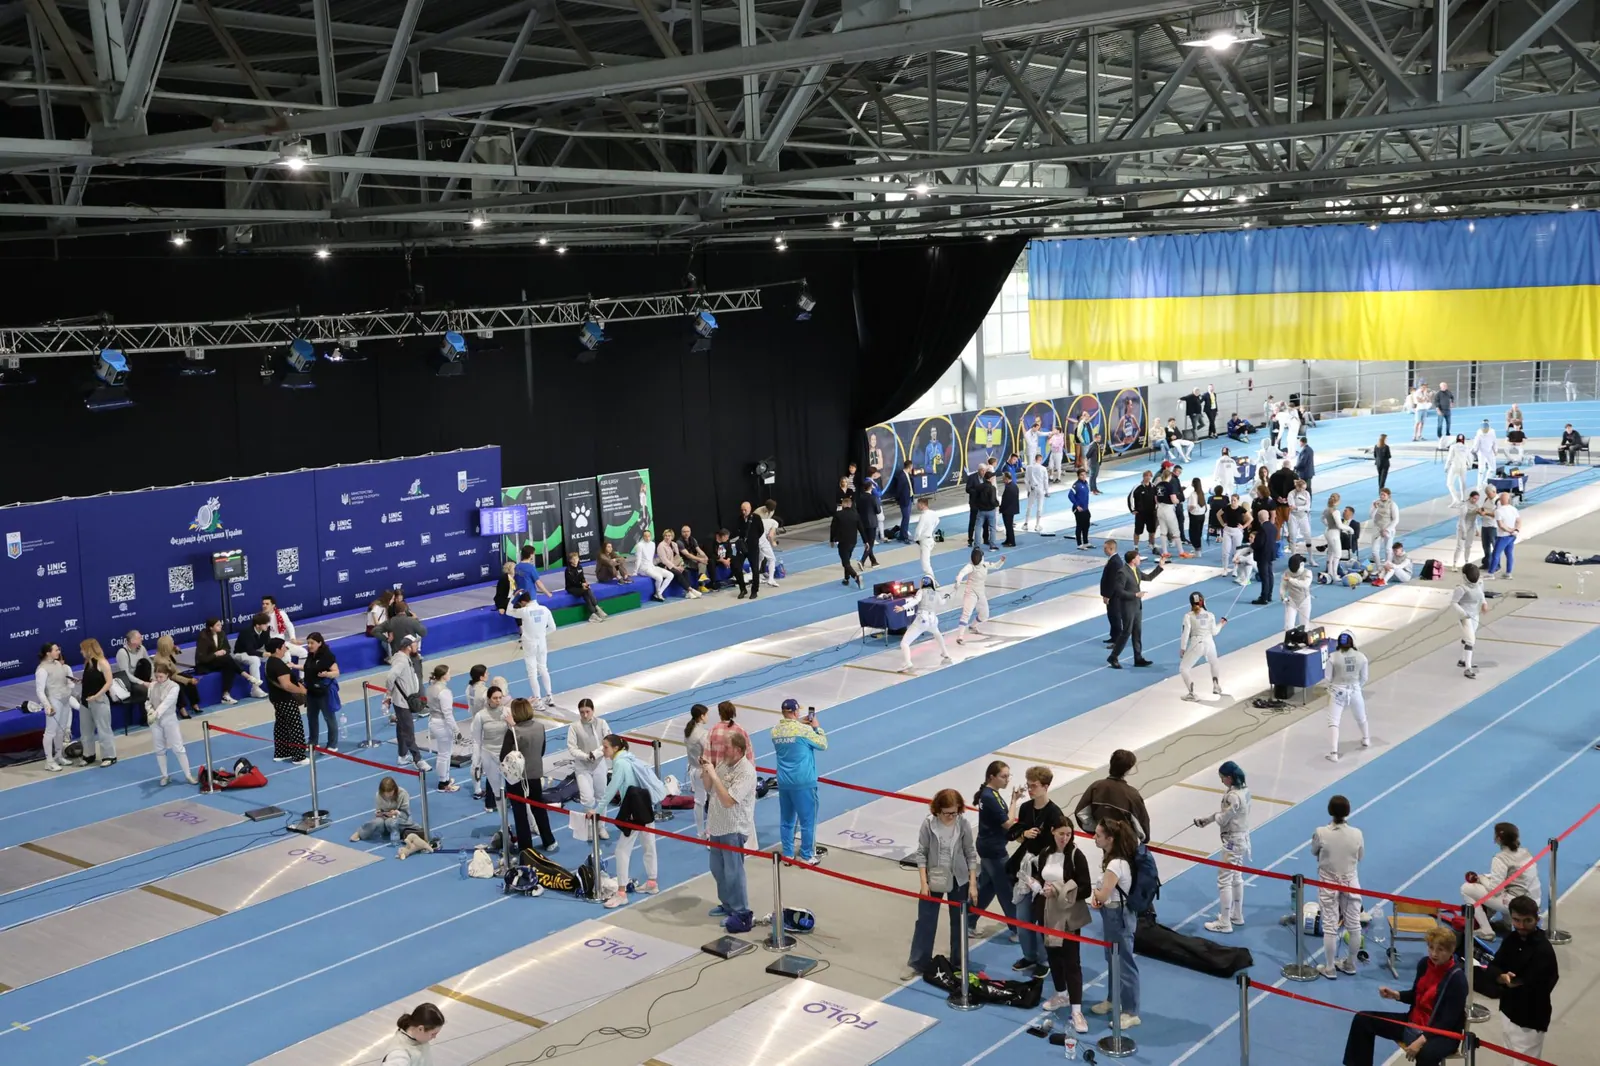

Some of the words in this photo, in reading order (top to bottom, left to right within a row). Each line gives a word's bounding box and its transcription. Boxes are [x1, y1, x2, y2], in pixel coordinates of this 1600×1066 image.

[481, 496, 494, 504] UNIC
[436, 503, 450, 511] UNIC
[387, 511, 402, 519] UNIC
[337, 519, 352, 527] UNIC
[571, 531, 594, 540] KELME
[47, 561, 67, 571] UNIC
[45, 596, 62, 604] UNIC
[10, 628, 39, 639] MASQUE
[838, 829, 895, 845] FOLO
[288, 848, 337, 866] FOLO
[584, 938, 648, 960] FOLO
[803, 1002, 878, 1030] FOLO
